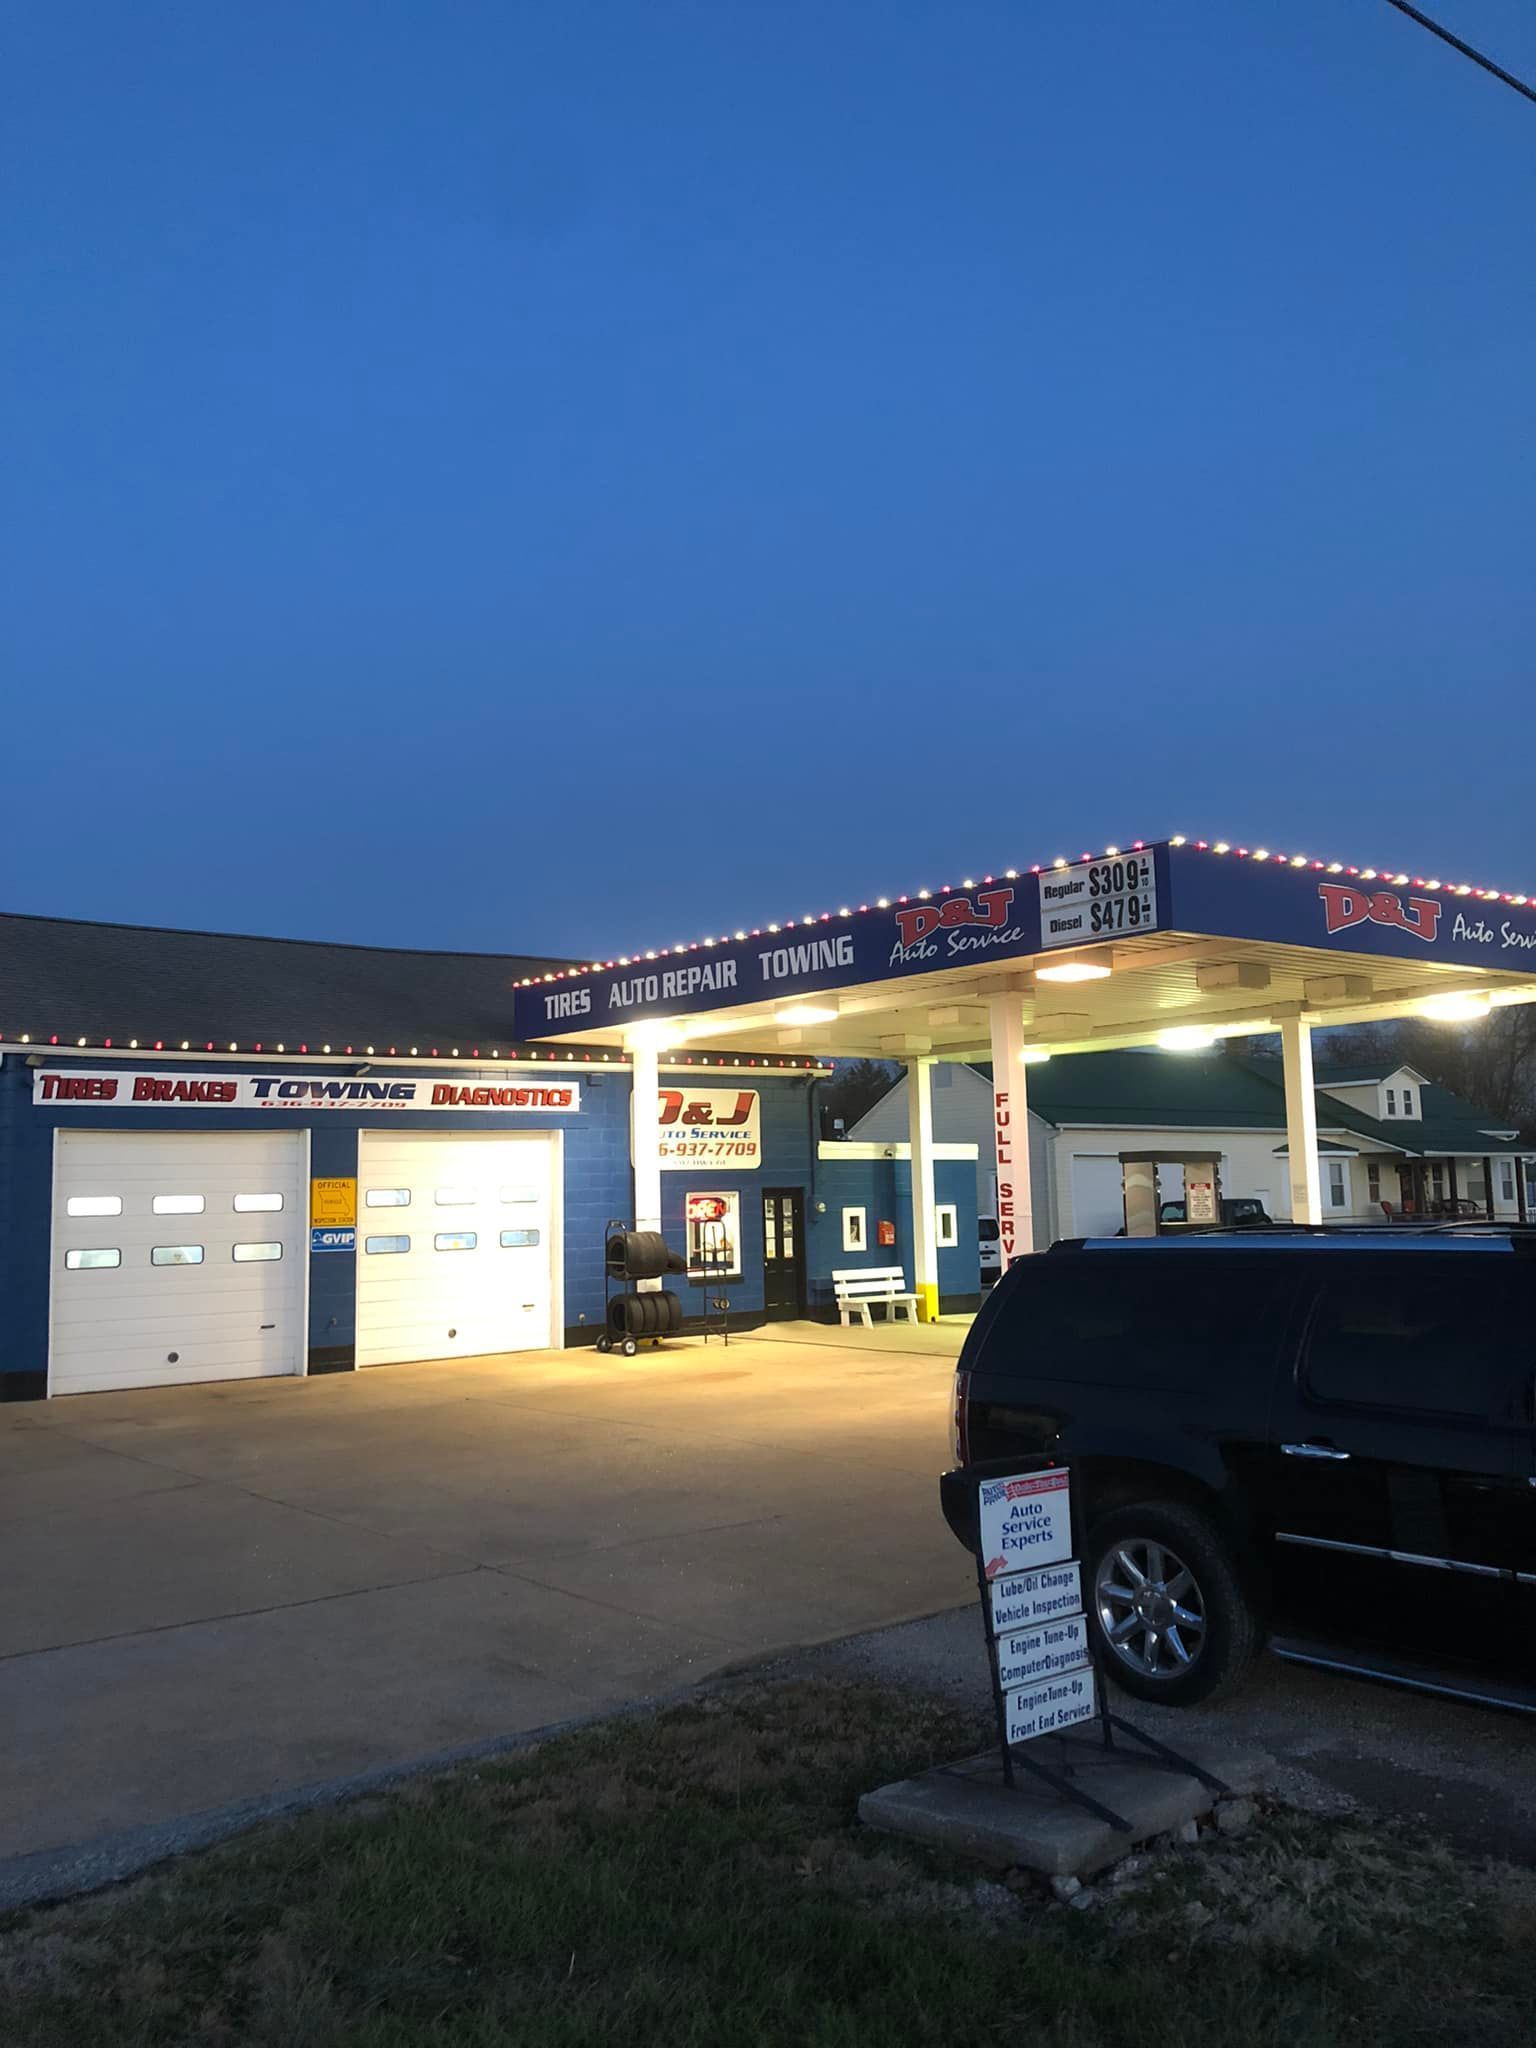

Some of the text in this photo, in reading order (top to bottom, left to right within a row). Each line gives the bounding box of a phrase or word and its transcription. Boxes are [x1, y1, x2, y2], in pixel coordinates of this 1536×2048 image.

[1044, 881, 1085, 899] Regular
[1088, 860, 1139, 897] $309
[895, 888, 1014, 951] D&J
[1050, 915, 1082, 933] Diesel
[1090, 895, 1140, 932] $479
[1318, 883, 1442, 942] D&J
[1452, 913, 1494, 942] Auto
[889, 925, 1024, 967] Auto Service
[544, 935, 855, 1020] TIRES AUTO REPAIR TOWING
[40, 1075, 573, 1107] TIRES BRAKES TOWING DIAGNOSTICS
[690, 1128, 752, 1139] SERVICE
[996, 1093, 1012, 1164] FULL
[658, 1142, 757, 1157] 6-937-7709
[317, 1181, 350, 1190] OFFICIAL
[688, 1202, 726, 1219] OPEN
[322, 1232, 354, 1244] GVIP
[1002, 1516, 1052, 1536] Service
[1010, 1503, 1043, 1519] Auto
[1001, 1530, 1053, 1550] Experts
[1001, 1572, 1074, 1598] Lube/Oil Change
[995, 1592, 1080, 1624] Vehicle Inspection
[1010, 1624, 1079, 1655] Engine Tune-Up
[1011, 1704, 1091, 1739] Front End Service
